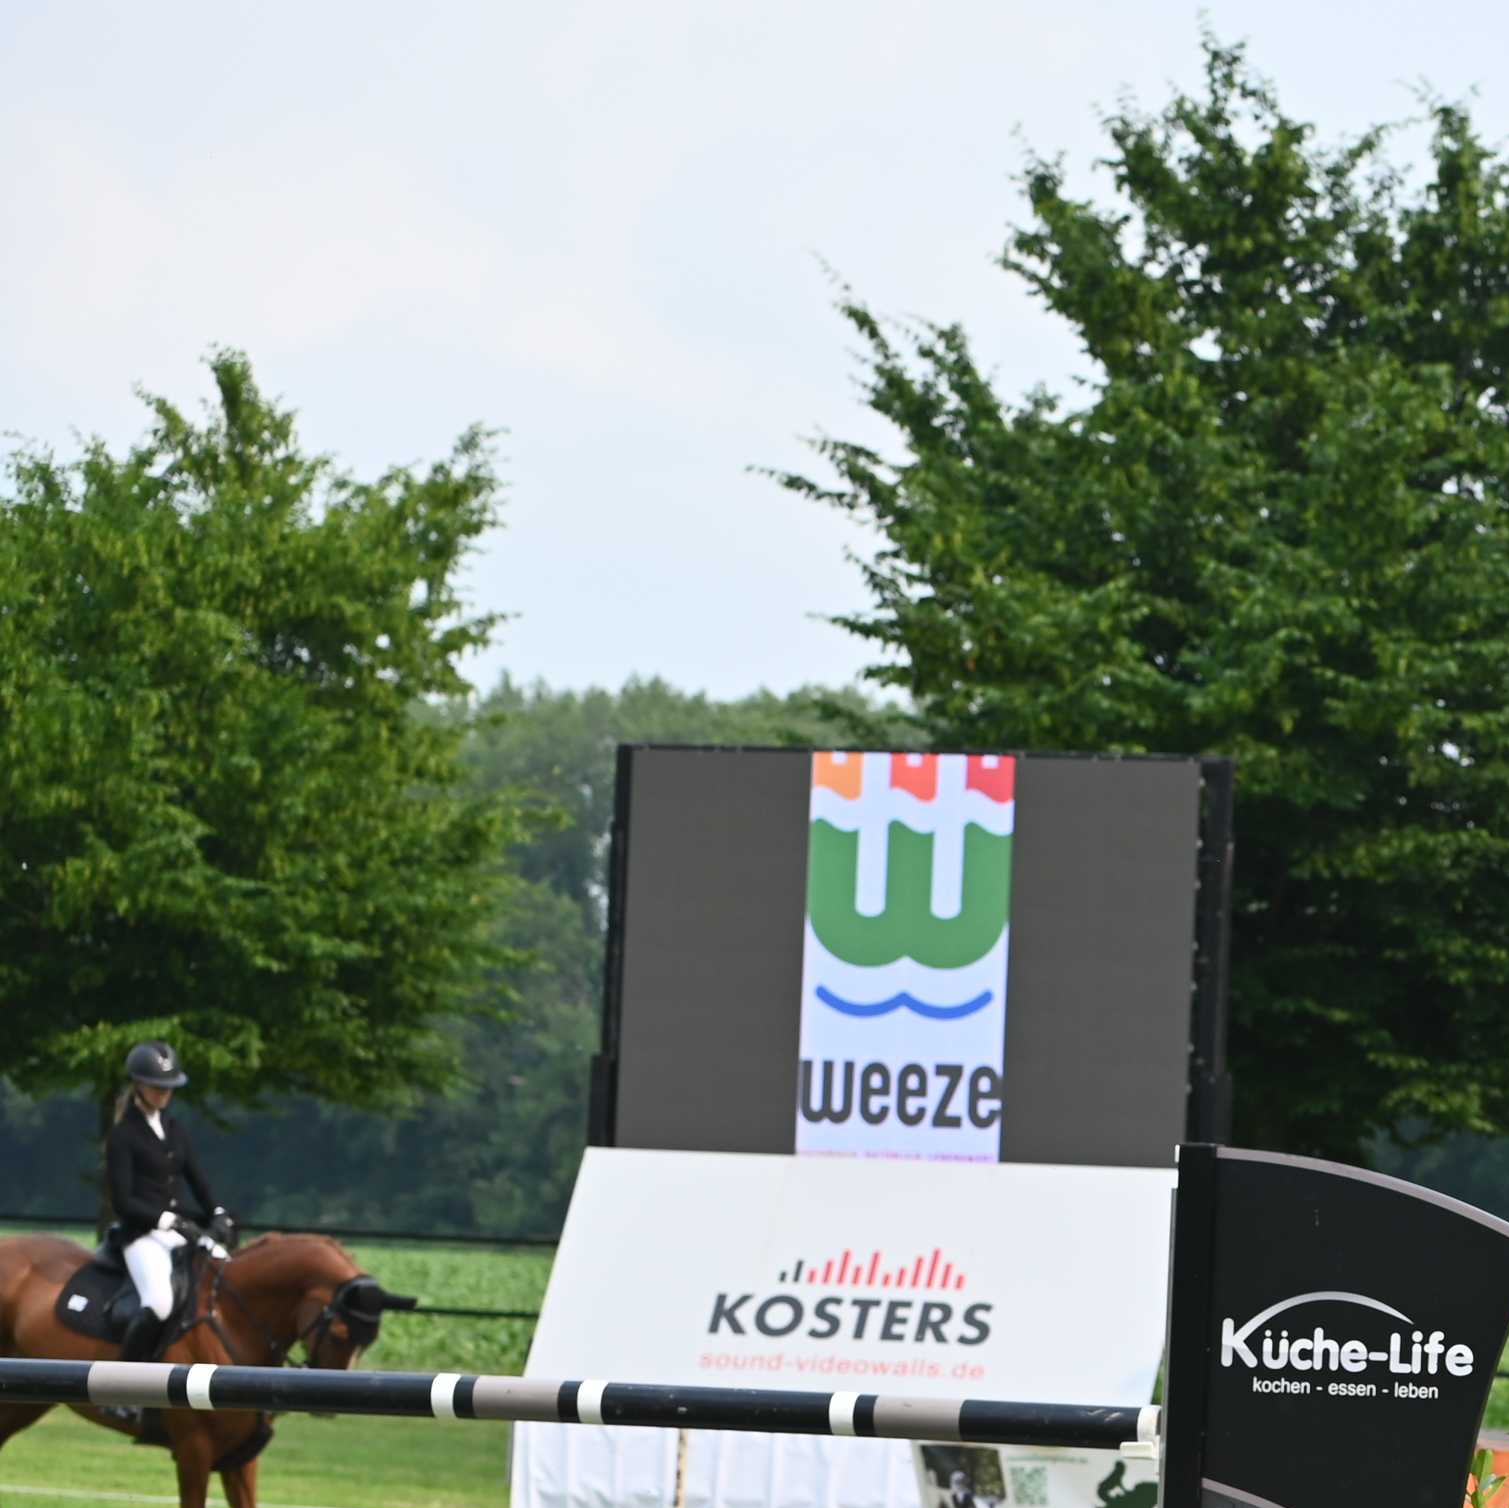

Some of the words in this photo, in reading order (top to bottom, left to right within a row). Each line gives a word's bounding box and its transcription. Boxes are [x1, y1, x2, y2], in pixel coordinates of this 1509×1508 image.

[801, 1060, 1001, 1129] weeze
[698, 1351, 985, 1381] sound-videowalls.de
[1221, 1317, 1474, 1377] Küche-Life
[1253, 1376, 1311, 1395] kochen
[1328, 1380, 1377, 1397] essen
[1394, 1381, 1439, 1400] leben
